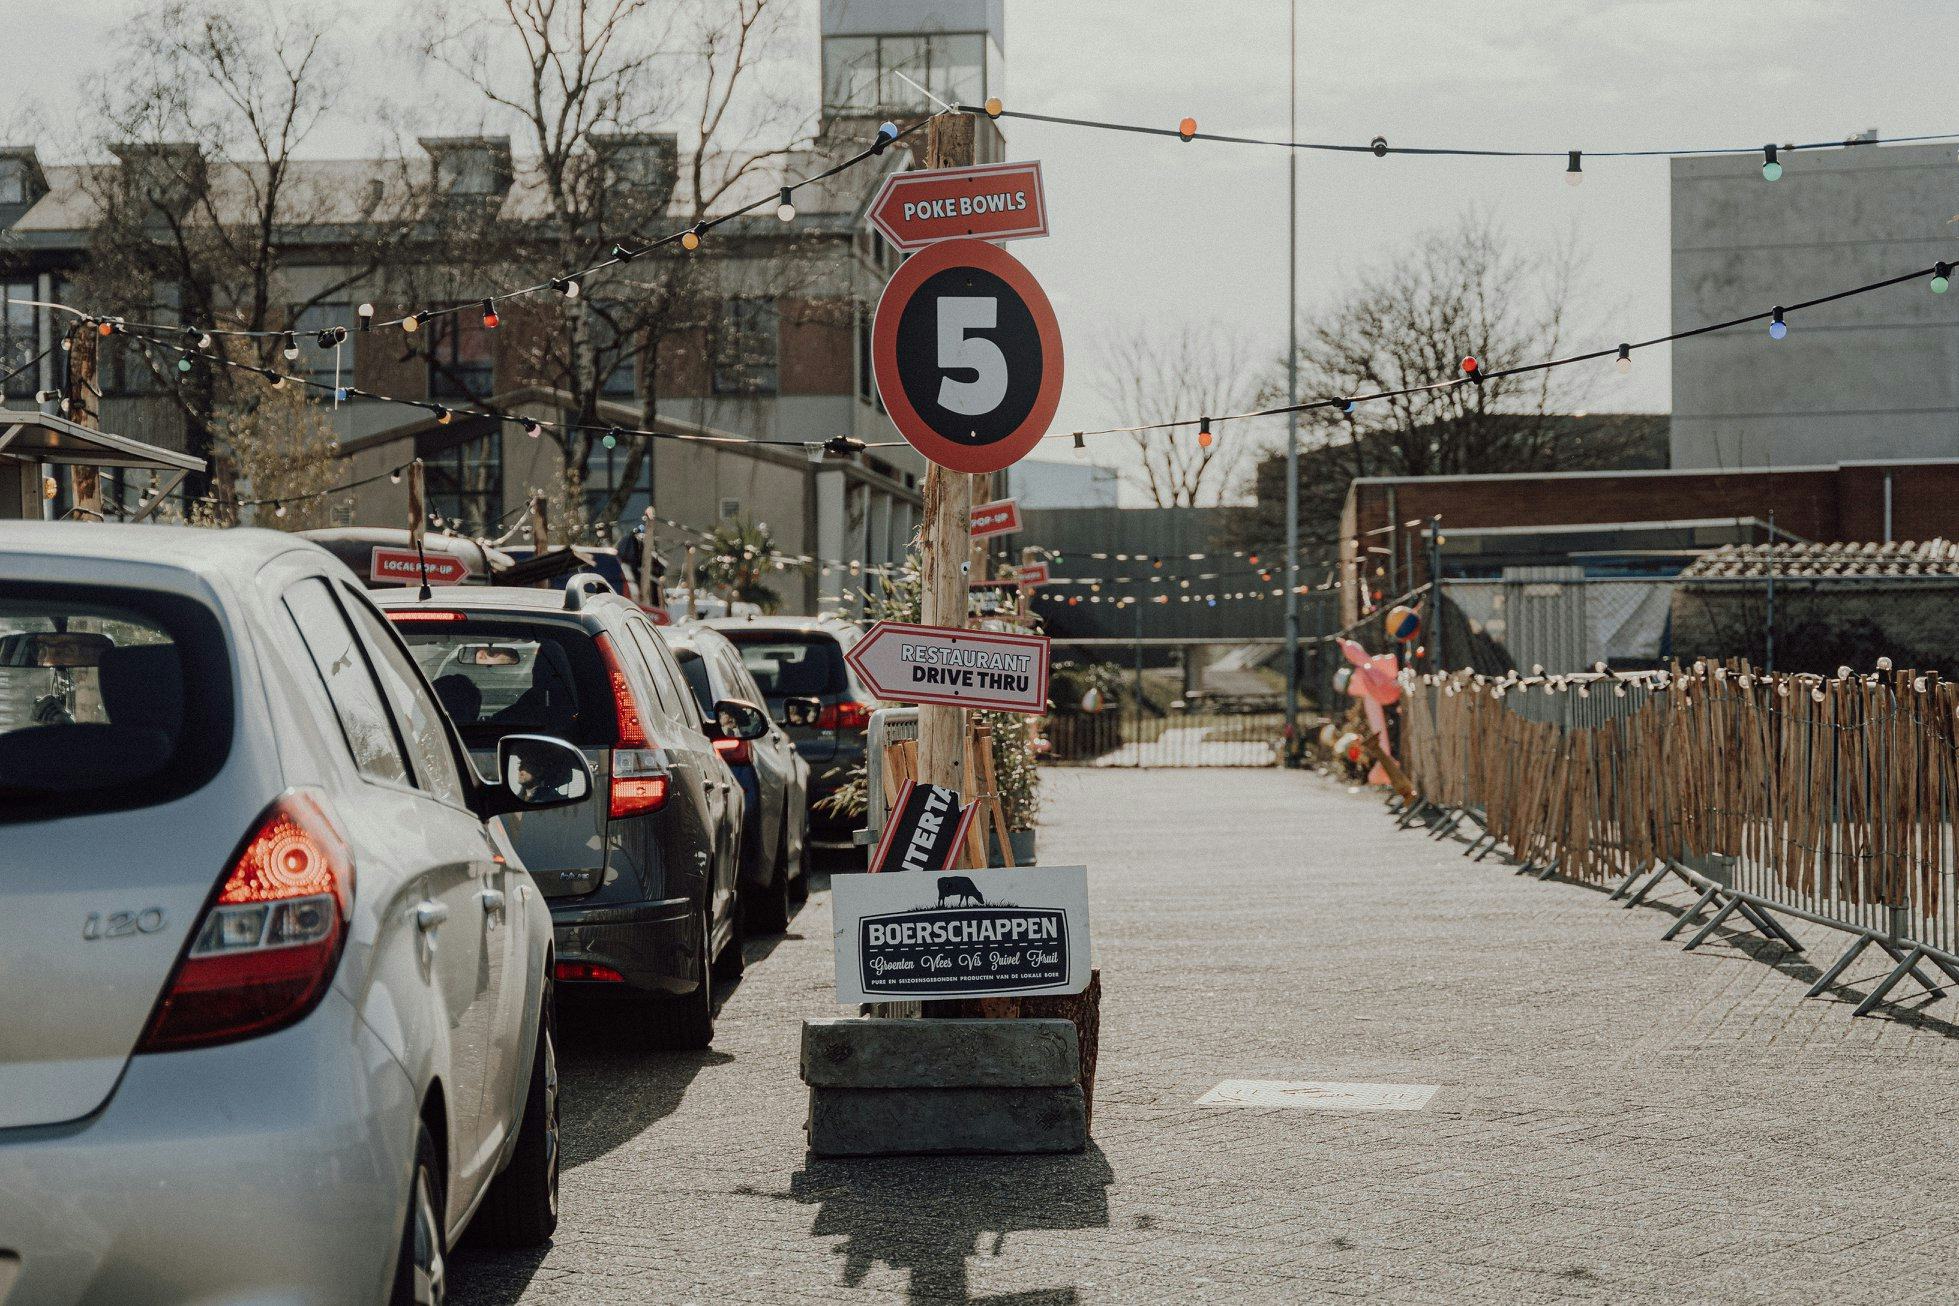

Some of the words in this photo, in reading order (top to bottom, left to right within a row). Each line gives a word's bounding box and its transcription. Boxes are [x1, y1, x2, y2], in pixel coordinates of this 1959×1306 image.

[904, 198, 957, 221] POKE
[959, 191, 1027, 216] BOWLS
[937, 296, 1008, 415] 5
[384, 560, 415, 572] LOCAL
[416, 563, 454, 575] POP-UP
[901, 643, 1031, 672] RESTAURANT
[912, 665, 974, 687] DRIVE
[977, 671, 1030, 692] THRU
[868, 916, 1058, 946] BOERSCHAPPEN
[870, 956, 915, 975] Groenten
[921, 954, 953, 971] Vlees
[958, 952, 982, 970] Vis
[989, 951, 1020, 970] Zuivel
[1026, 949, 1059, 968] Fruit
